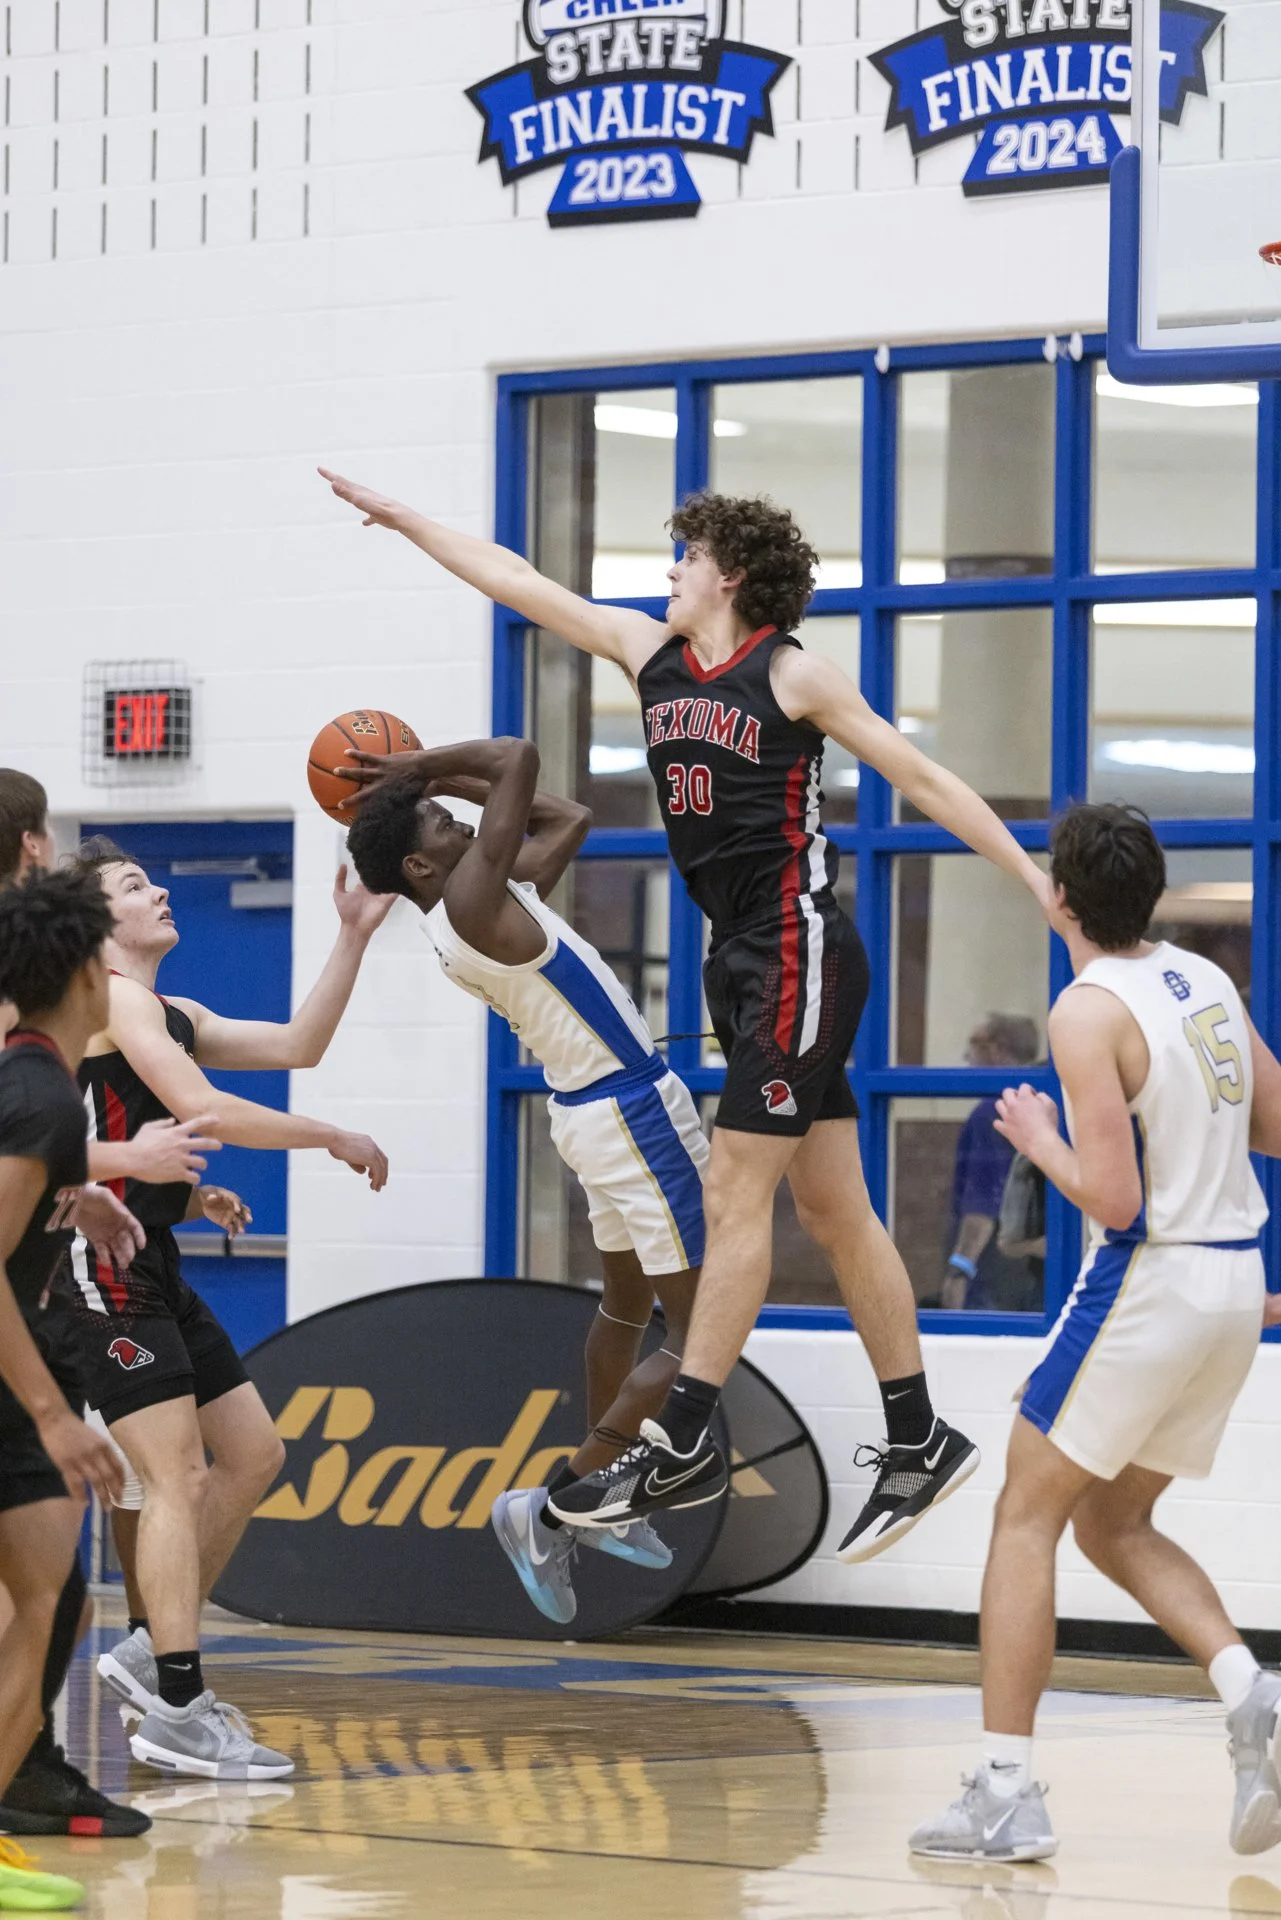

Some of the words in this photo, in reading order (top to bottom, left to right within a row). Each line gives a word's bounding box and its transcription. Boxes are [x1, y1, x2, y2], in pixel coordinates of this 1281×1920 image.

[547, 17, 706, 85] STATE
[960, 0, 1131, 48] STATE
[510, 83, 746, 164] FINALIST
[985, 115, 1107, 175] 2024
[568, 152, 678, 206] 2023
[114, 693, 169, 752] EXIT
[645, 698, 762, 765] EXOMA
[666, 763, 713, 816] 30
[1181, 1002, 1245, 1114] 15
